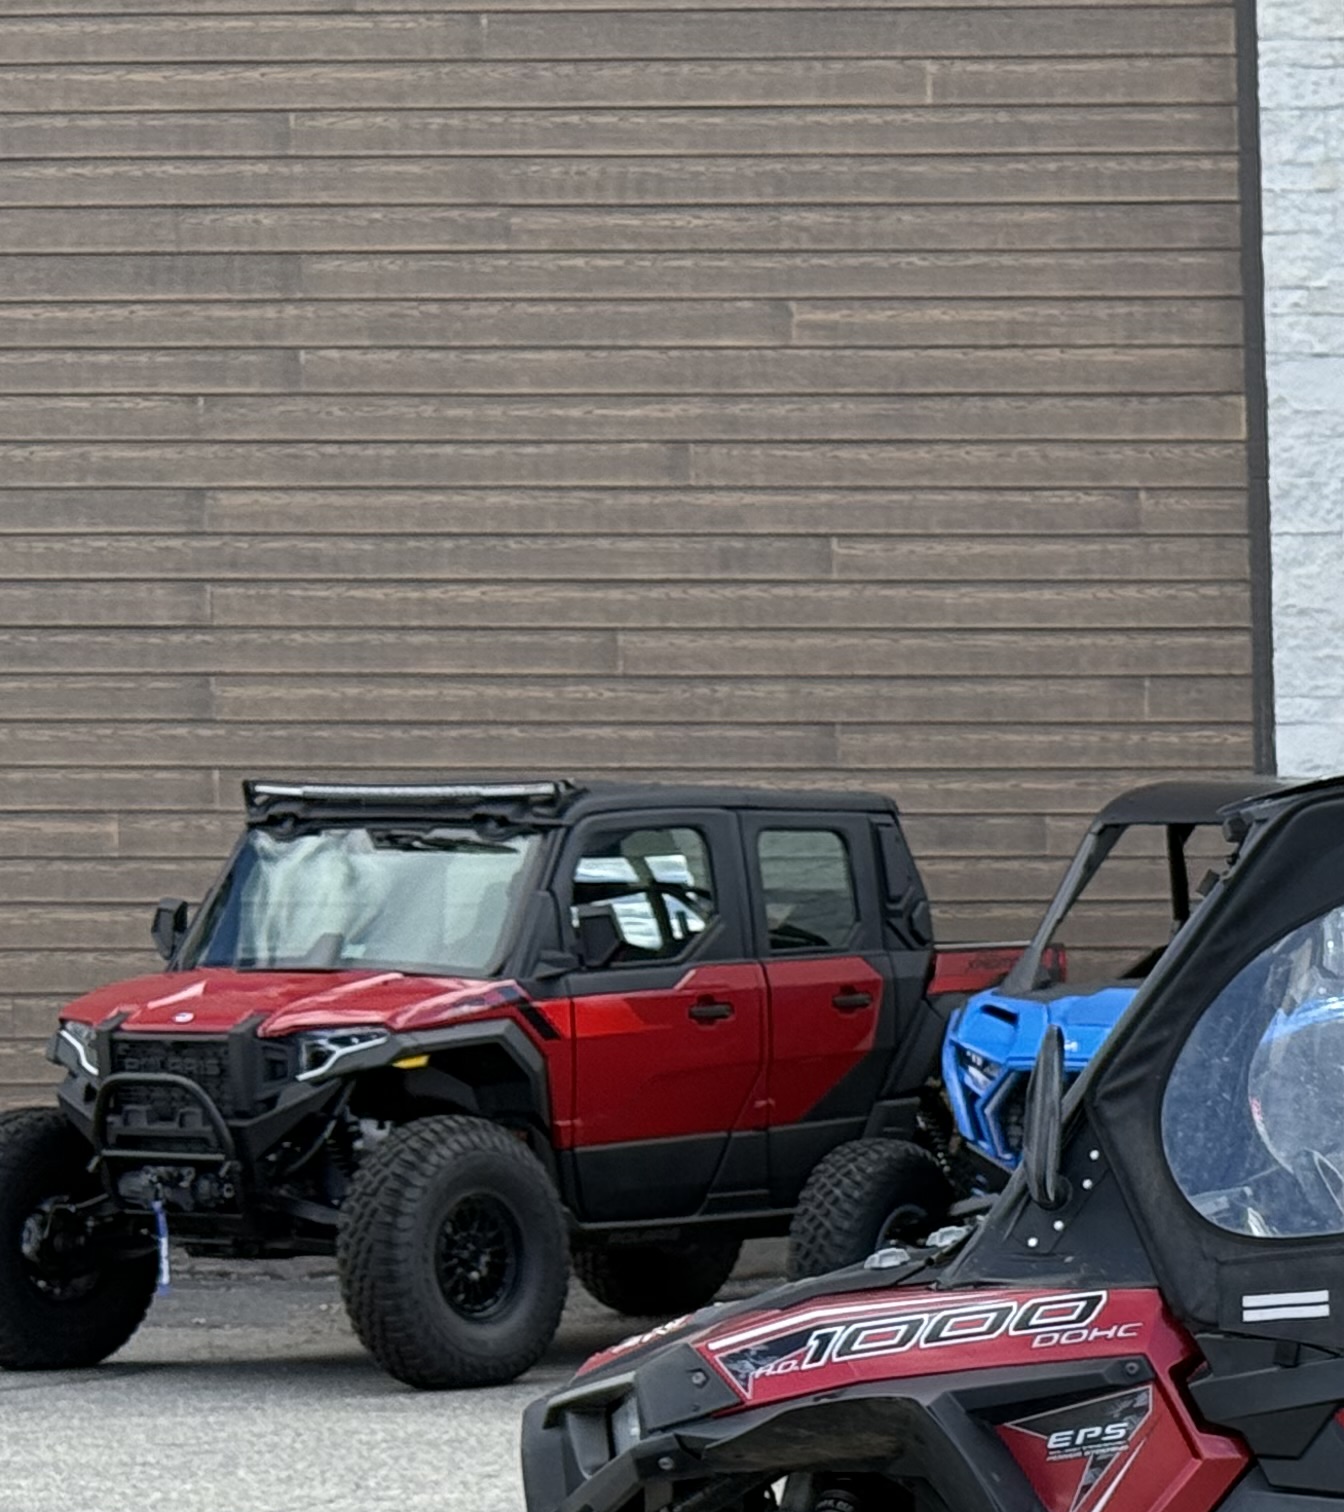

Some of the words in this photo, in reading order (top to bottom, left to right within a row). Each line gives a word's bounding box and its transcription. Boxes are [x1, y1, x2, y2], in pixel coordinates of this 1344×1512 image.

[801, 1290, 1107, 1370] 1000
[1031, 1322, 1144, 1349] DOHC
[1047, 1422, 1129, 1449] EPS
